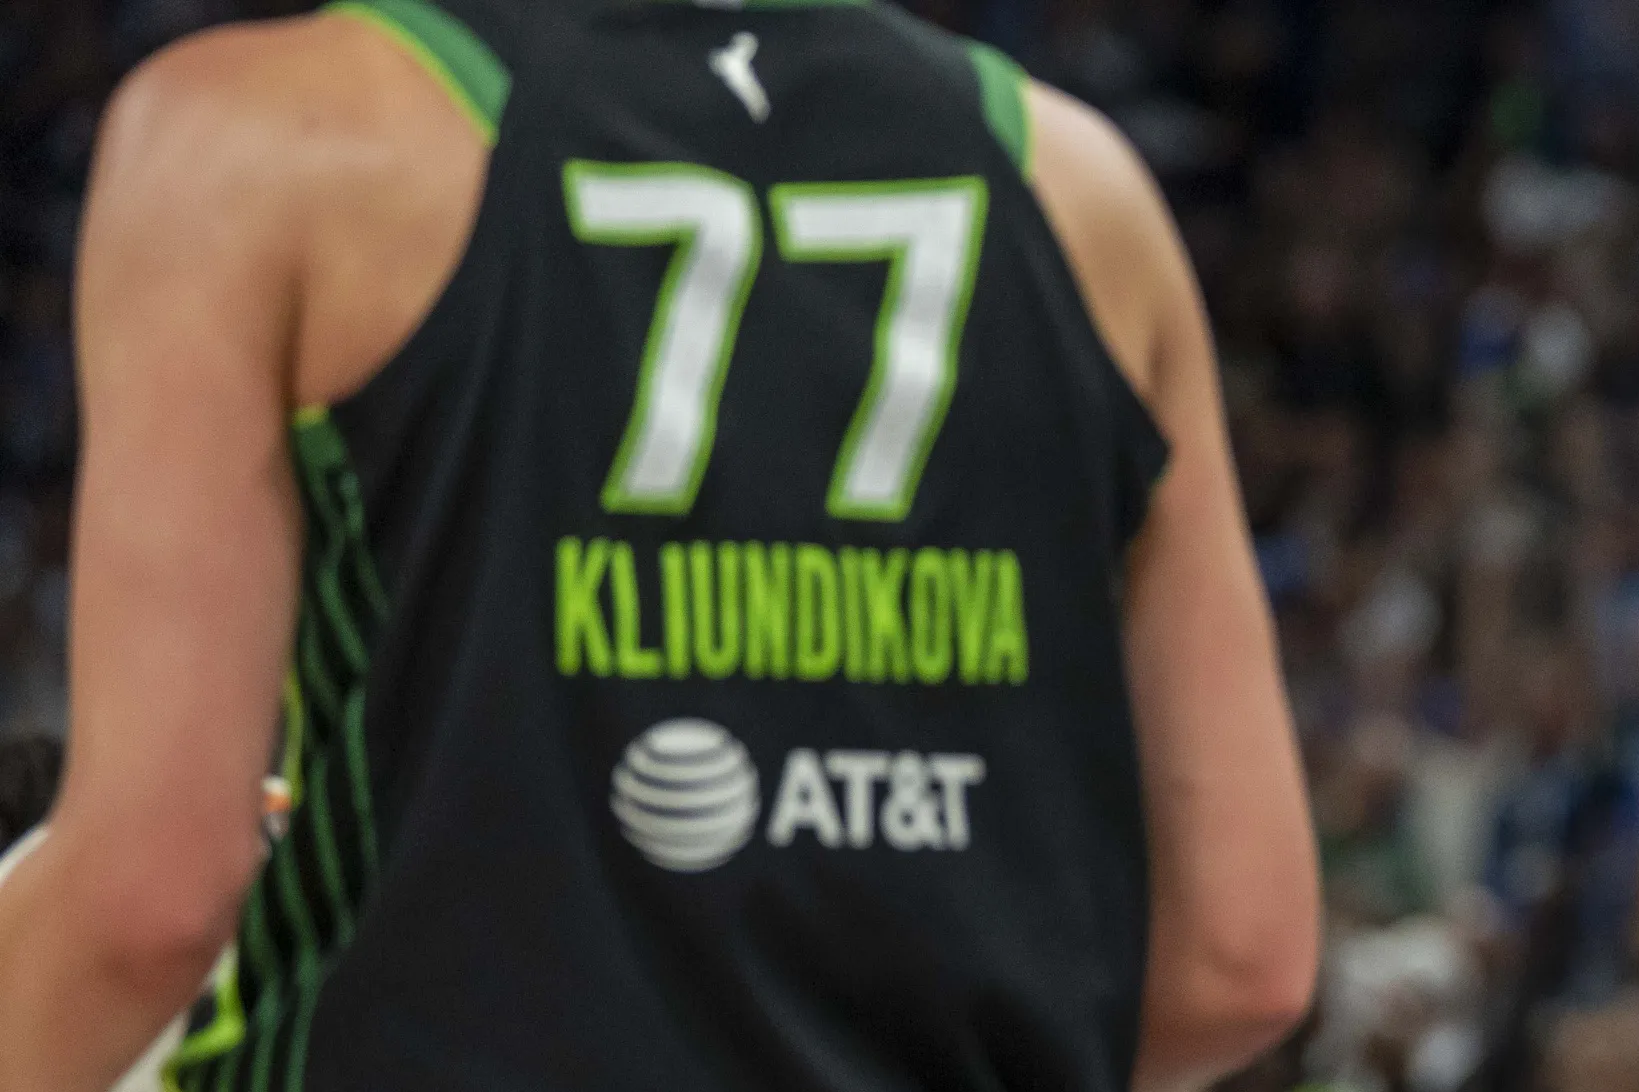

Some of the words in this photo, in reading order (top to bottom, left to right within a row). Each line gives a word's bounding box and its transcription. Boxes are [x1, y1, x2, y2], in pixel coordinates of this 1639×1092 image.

[562, 159, 988, 521] 77
[555, 536, 1029, 685] KLIUNDIKOVA
[767, 747, 986, 850] AT&T
